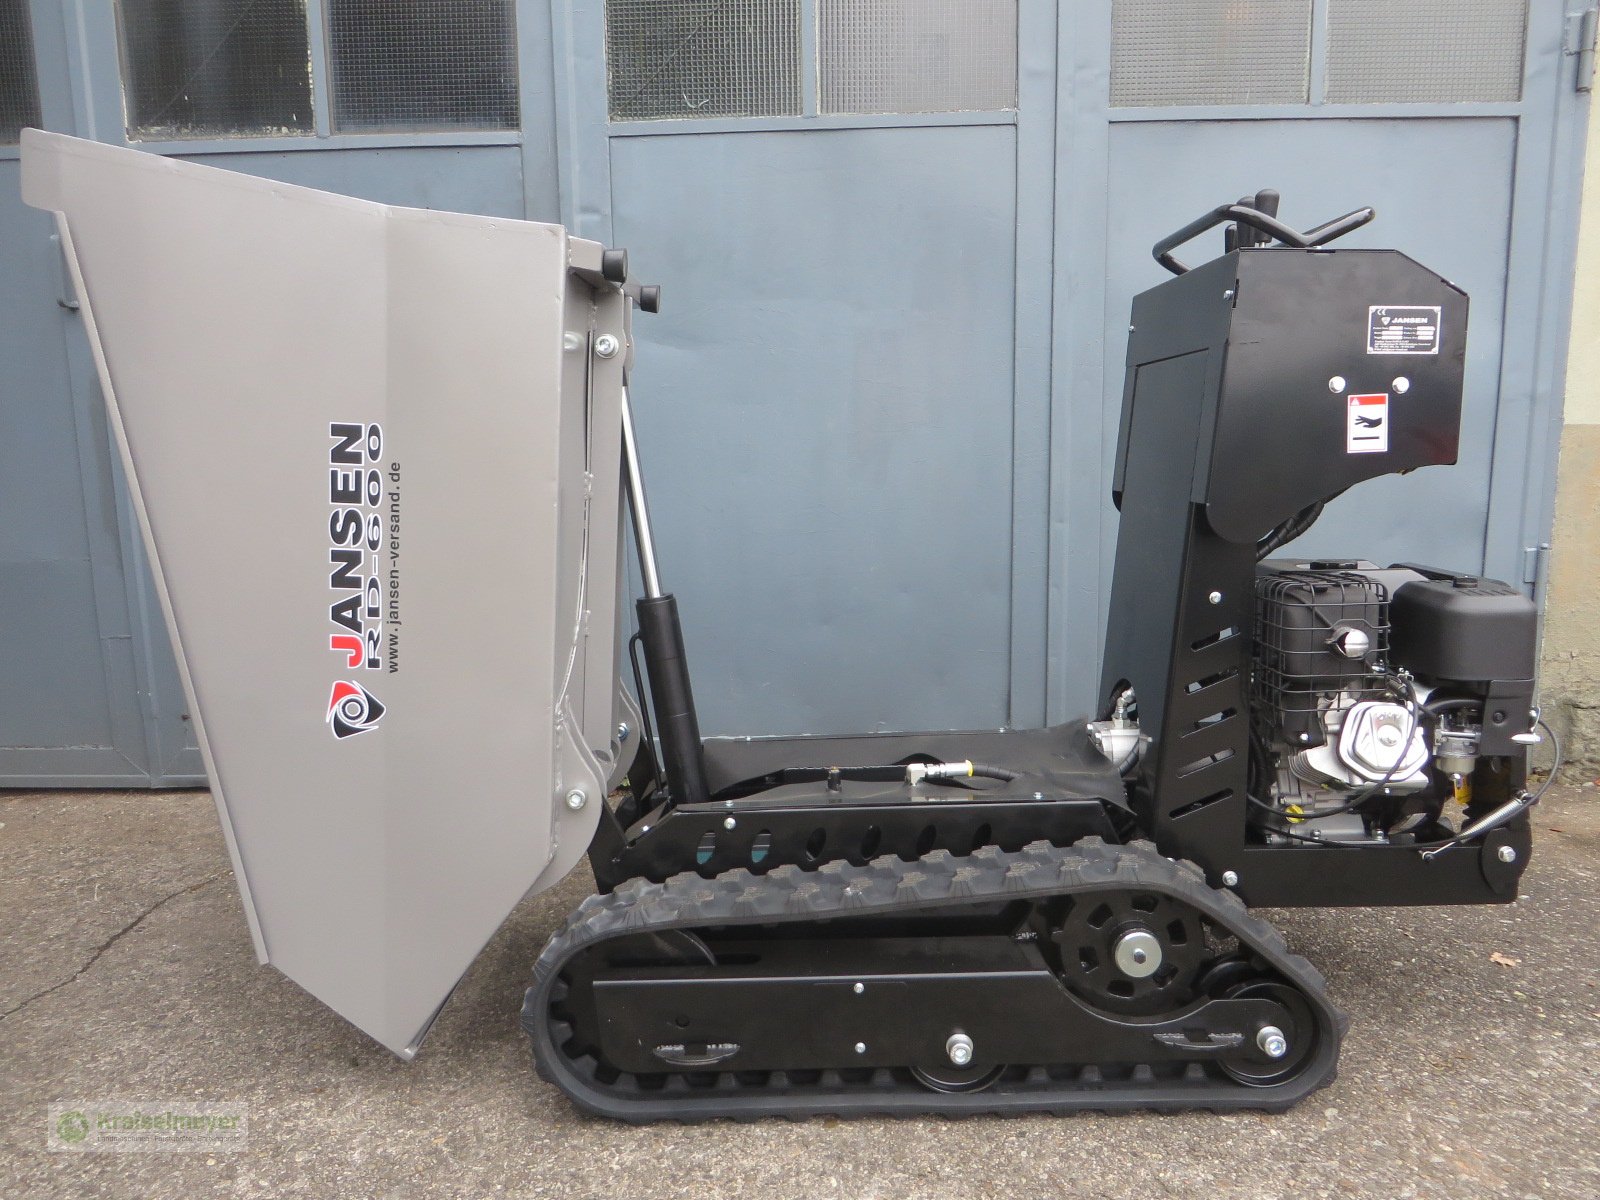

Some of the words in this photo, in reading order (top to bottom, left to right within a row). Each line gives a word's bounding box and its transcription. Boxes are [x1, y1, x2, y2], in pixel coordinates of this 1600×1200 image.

[329, 422, 365, 668] JANSEN
[366, 422, 383, 669] RD-600
[386, 462, 401, 673] www.jansen-versand.de
